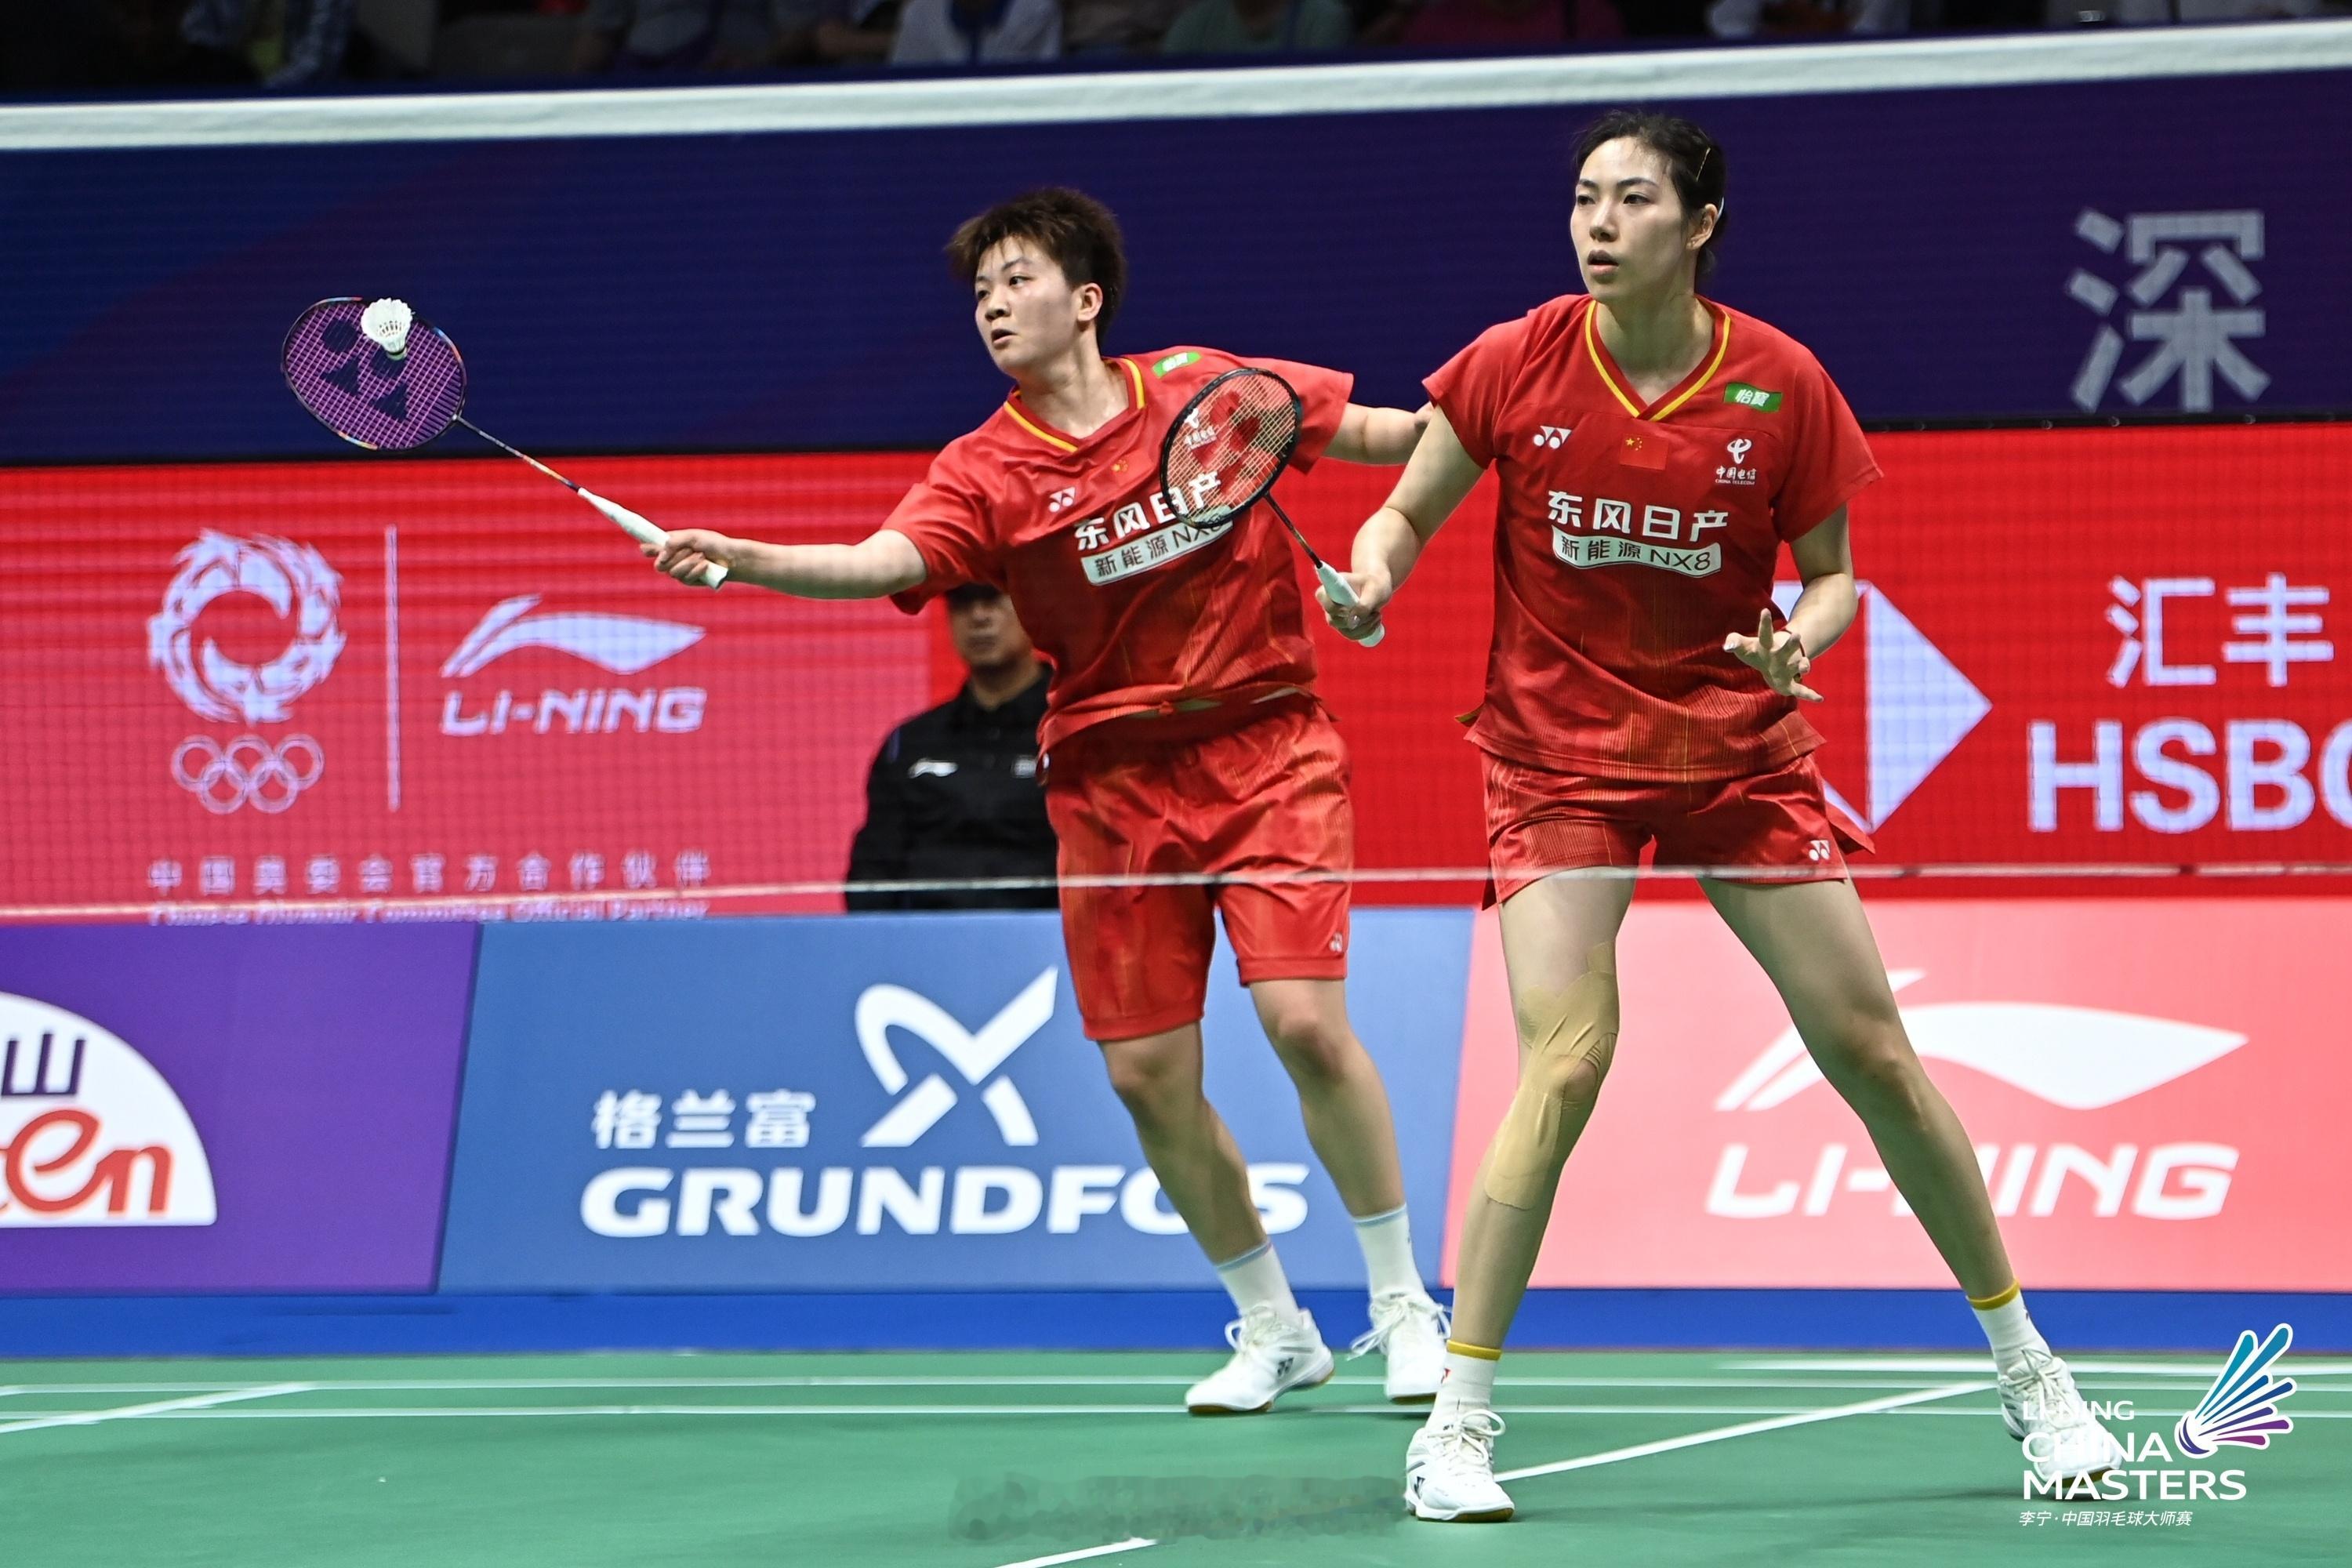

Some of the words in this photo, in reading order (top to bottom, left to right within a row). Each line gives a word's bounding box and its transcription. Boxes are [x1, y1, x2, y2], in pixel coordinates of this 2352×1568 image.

[2065, 207, 2270, 413] 深
[1075, 471, 1221, 550] 东风日产
[1094, 511, 1223, 578] 新能源NX
[1548, 489, 1729, 542] 东风日产
[2105, 572, 2335, 688] 汇丰
[441, 686, 706, 735] LI-NING
[591, 1088, 816, 1149] 格兰富
[0, 1109, 172, 1212] en
